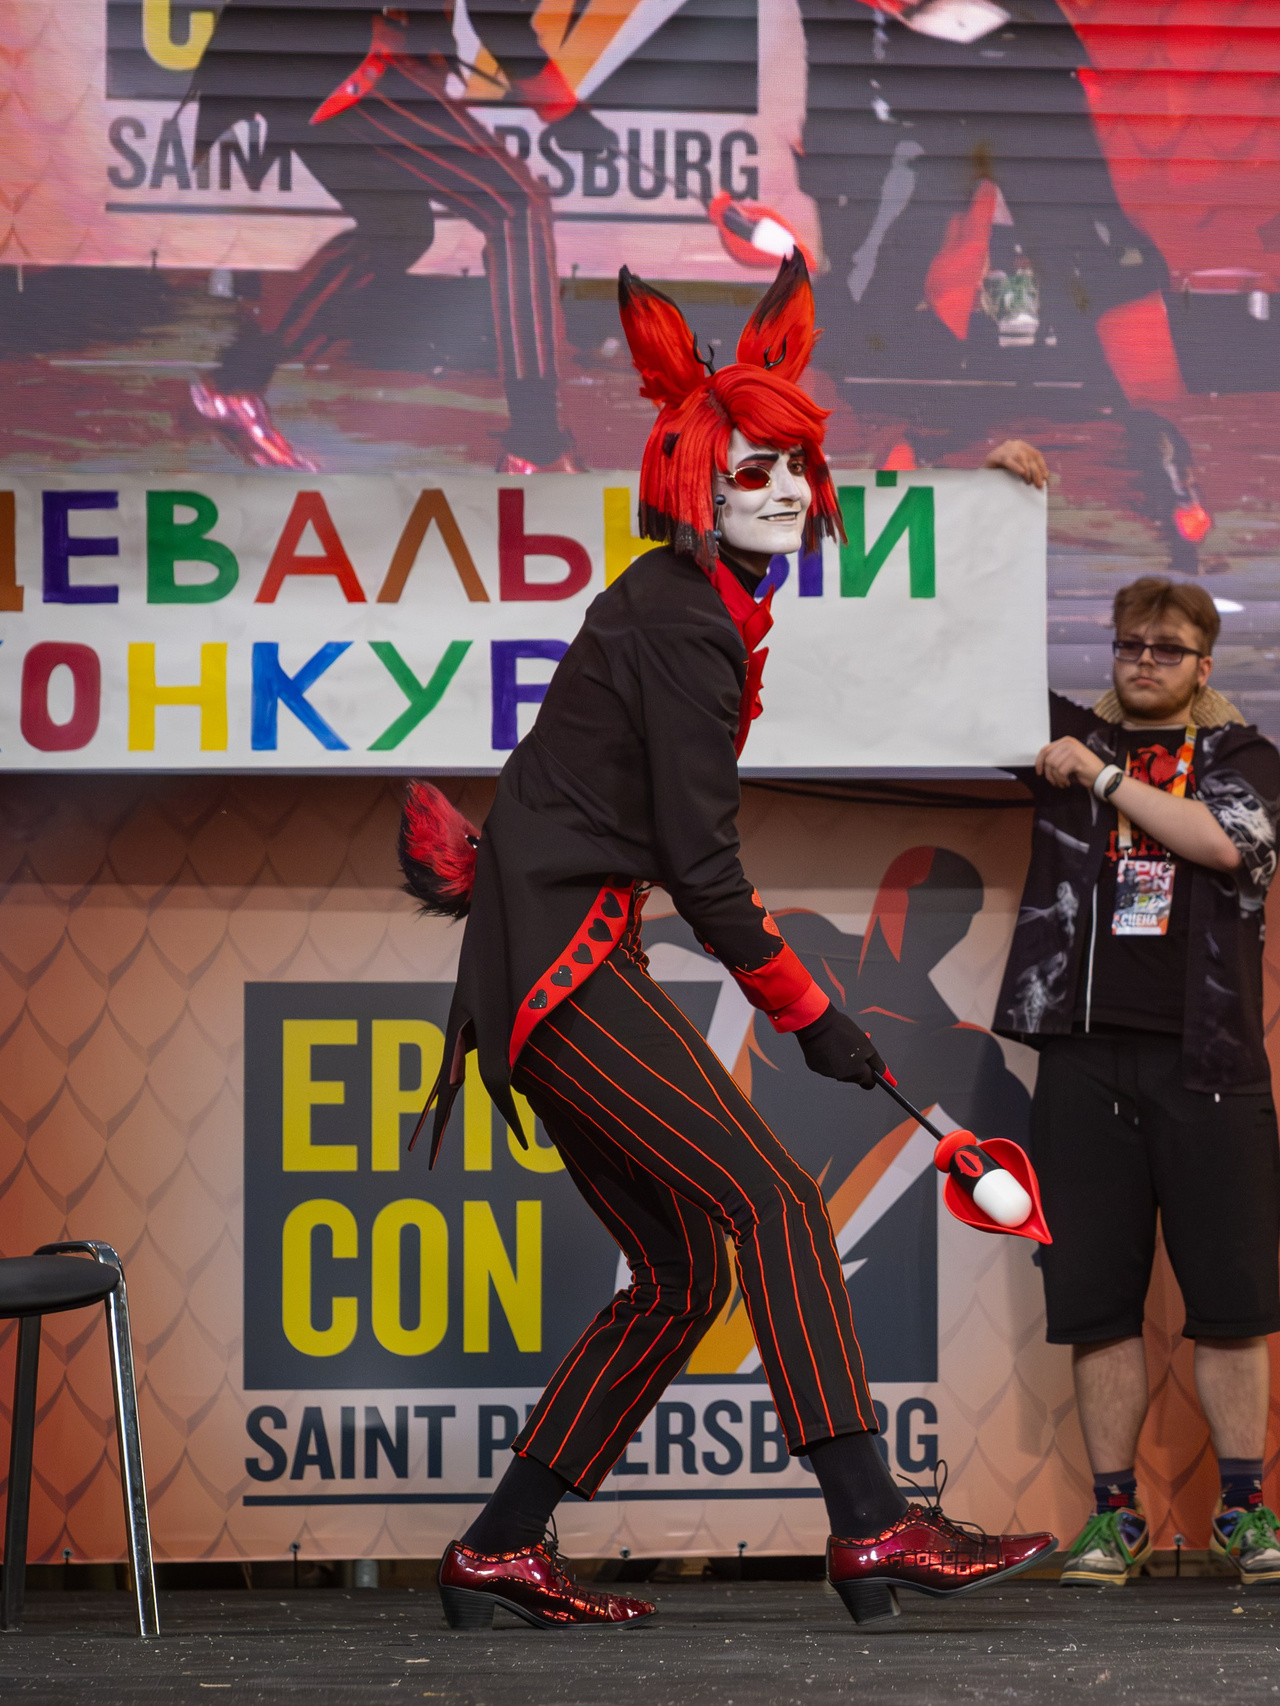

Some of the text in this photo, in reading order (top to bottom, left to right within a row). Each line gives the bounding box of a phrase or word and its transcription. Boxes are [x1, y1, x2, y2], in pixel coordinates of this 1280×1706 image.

[0, 639, 570, 752] ОНКУР
[282, 1199, 542, 1357] CON
[245, 1405, 456, 1482] SAINT
